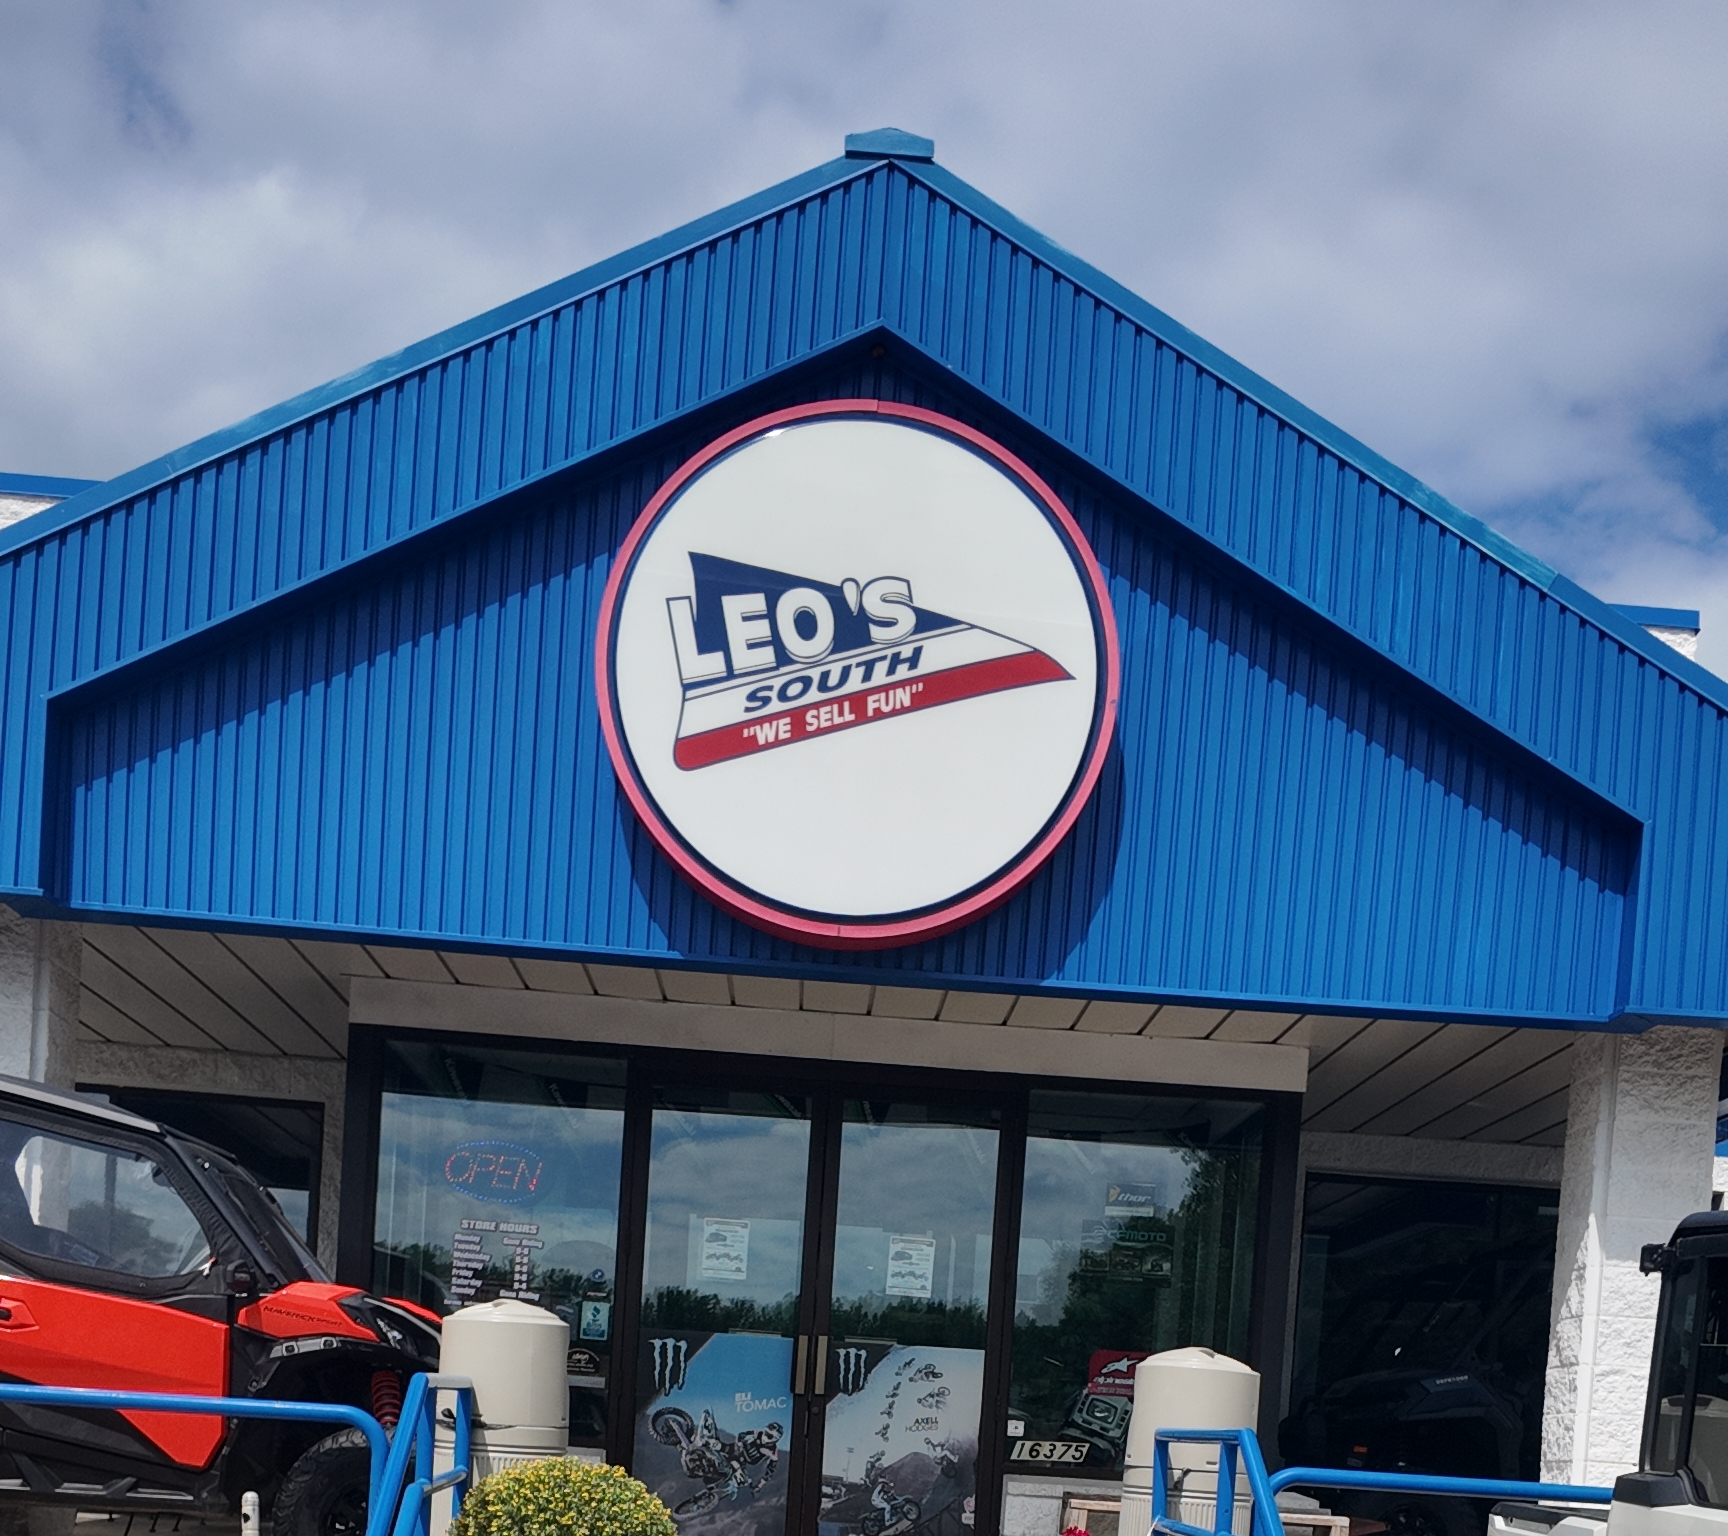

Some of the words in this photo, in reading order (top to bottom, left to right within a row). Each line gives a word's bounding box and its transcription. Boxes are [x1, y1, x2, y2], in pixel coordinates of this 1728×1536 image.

[665, 575, 917, 684] LEO'S
[743, 645, 924, 713] SOUTH
[742, 717, 792, 746] "WE
[805, 701, 856, 732] SELL
[866, 682, 924, 717] FUN"
[445, 1151, 542, 1191] OPEN
[461, 1219, 497, 1231] STORE
[499, 1222, 538, 1234] HOURS
[1107, 1229, 1167, 1242] CFMOTO
[735, 1397, 787, 1412] TOMAC
[1017, 1442, 1086, 1461] 16375
